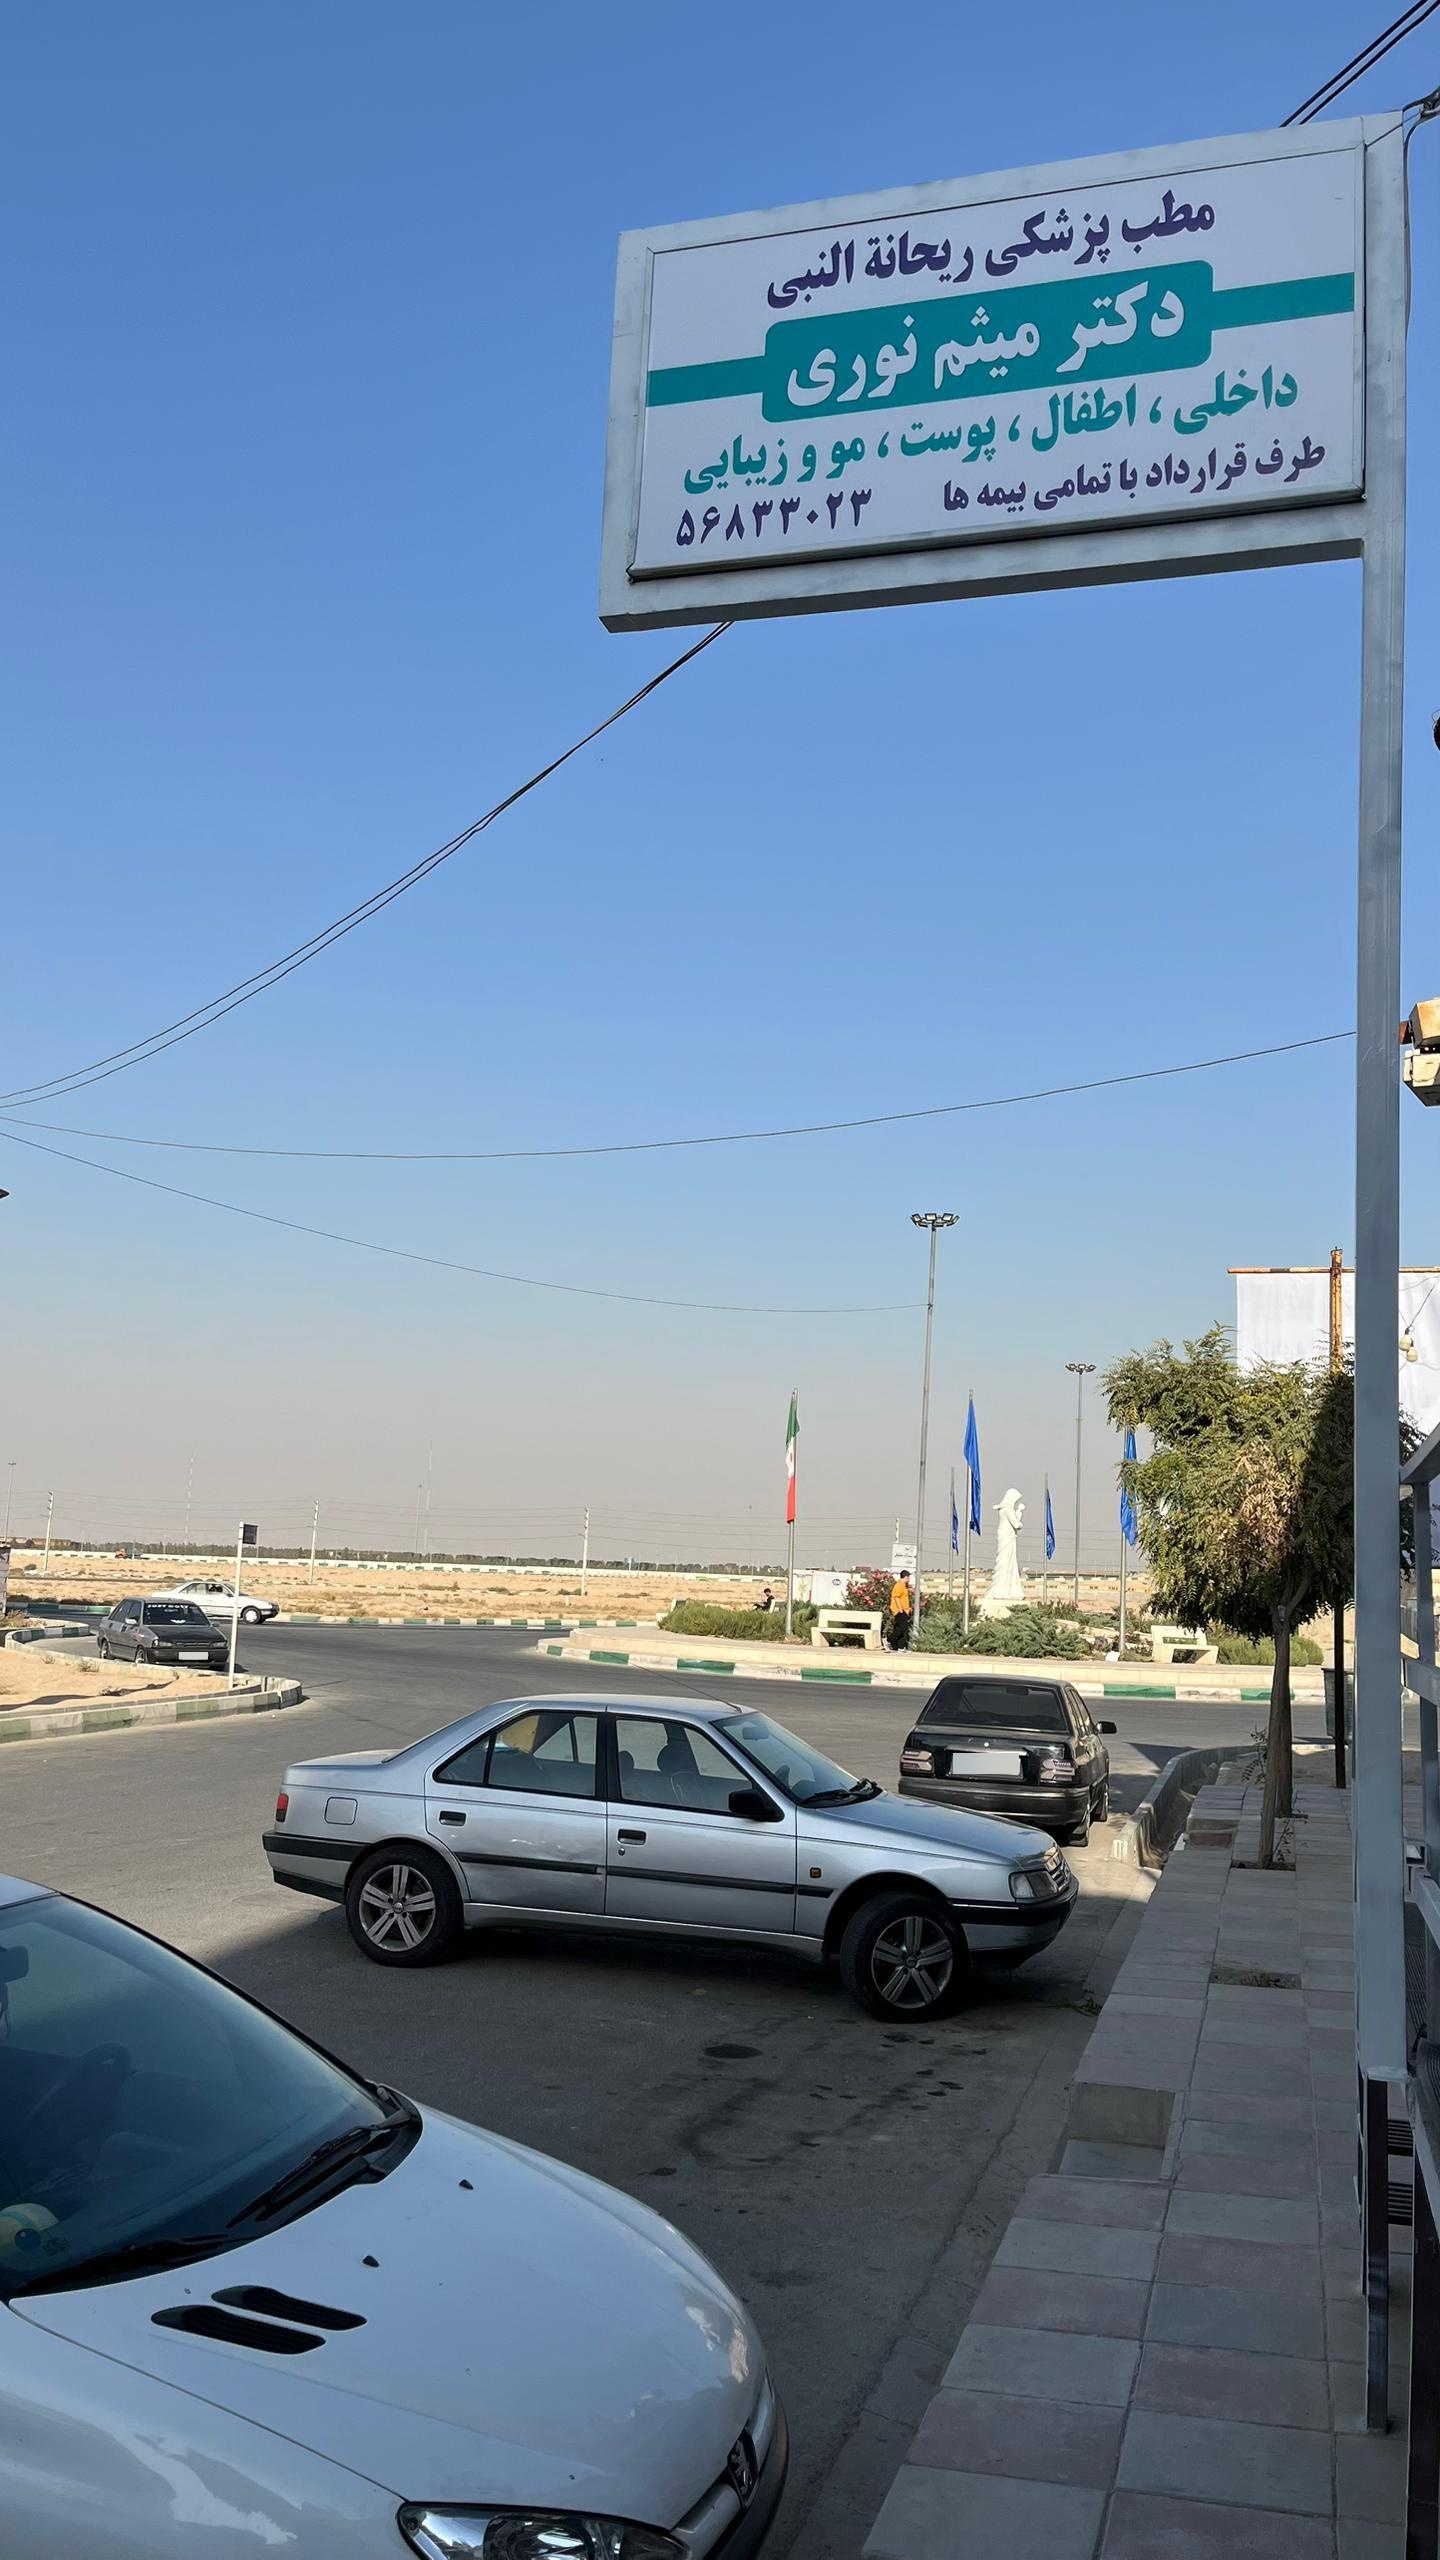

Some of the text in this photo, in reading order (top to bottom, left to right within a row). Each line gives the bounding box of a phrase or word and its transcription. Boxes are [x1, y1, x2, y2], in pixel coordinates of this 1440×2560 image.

[984, 207, 1111, 277] پزشکی
[1121, 189, 1216, 255] مطب
[766, 238, 856, 309] النبی
[786, 280, 1185, 407] دکتر میثم نوری
[683, 434, 789, 495] زیبایی
[796, 443, 818, 484] و
[825, 436, 867, 480] مو
[1033, 460, 1113, 512] تمامی
[1119, 457, 1138, 500] با
[1254, 435, 1327, 484] طرف
[675, 487, 874, 547] ۵۶۸۳۳۰۲۳
